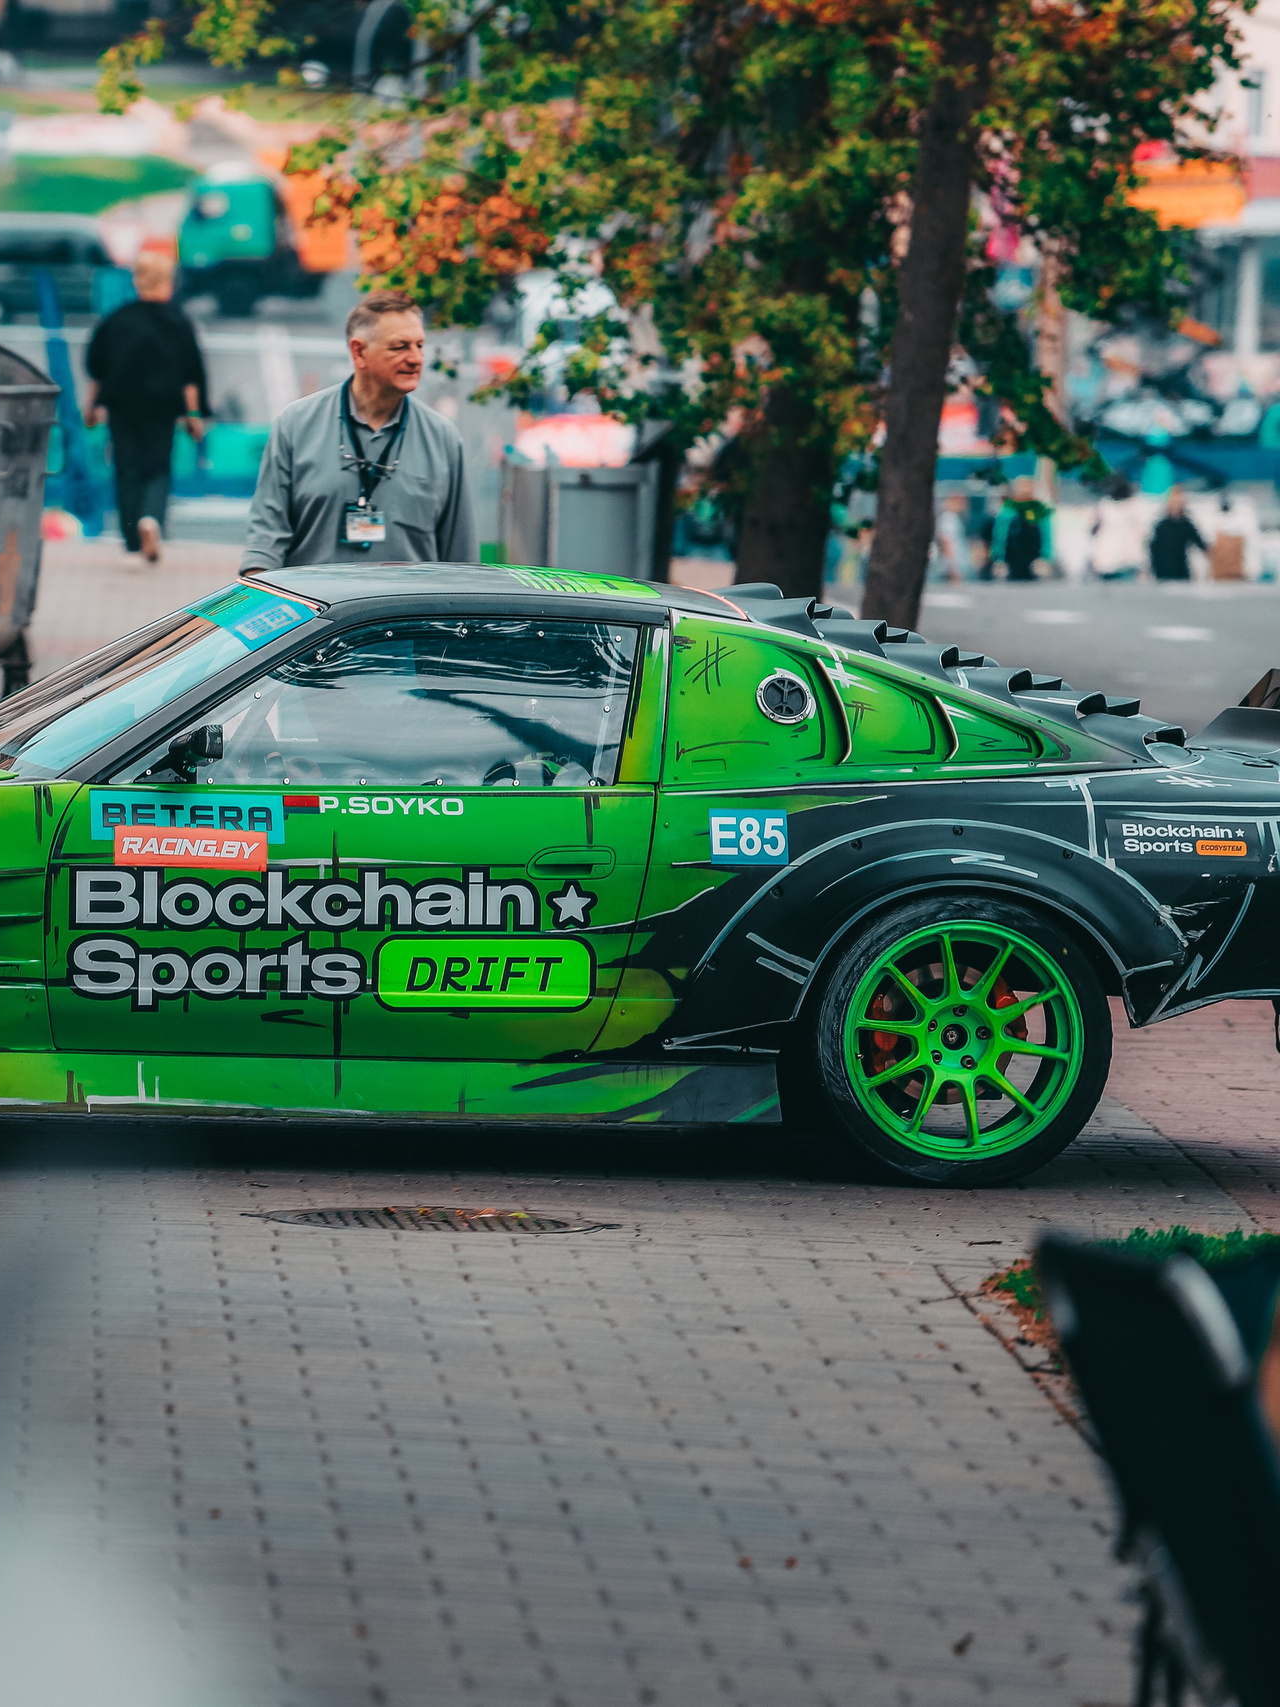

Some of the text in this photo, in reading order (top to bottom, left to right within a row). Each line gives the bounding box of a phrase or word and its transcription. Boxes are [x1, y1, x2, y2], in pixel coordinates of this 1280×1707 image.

[101, 803, 273, 831] BETERA
[319, 796, 464, 816] P.SOYKO
[711, 816, 786, 857] E85
[1121, 823, 1233, 838] Blockchain
[1124, 838, 1193, 854] Sports
[75, 870, 536, 927] Blockchain
[72, 938, 563, 1006] Sports DRIFT
